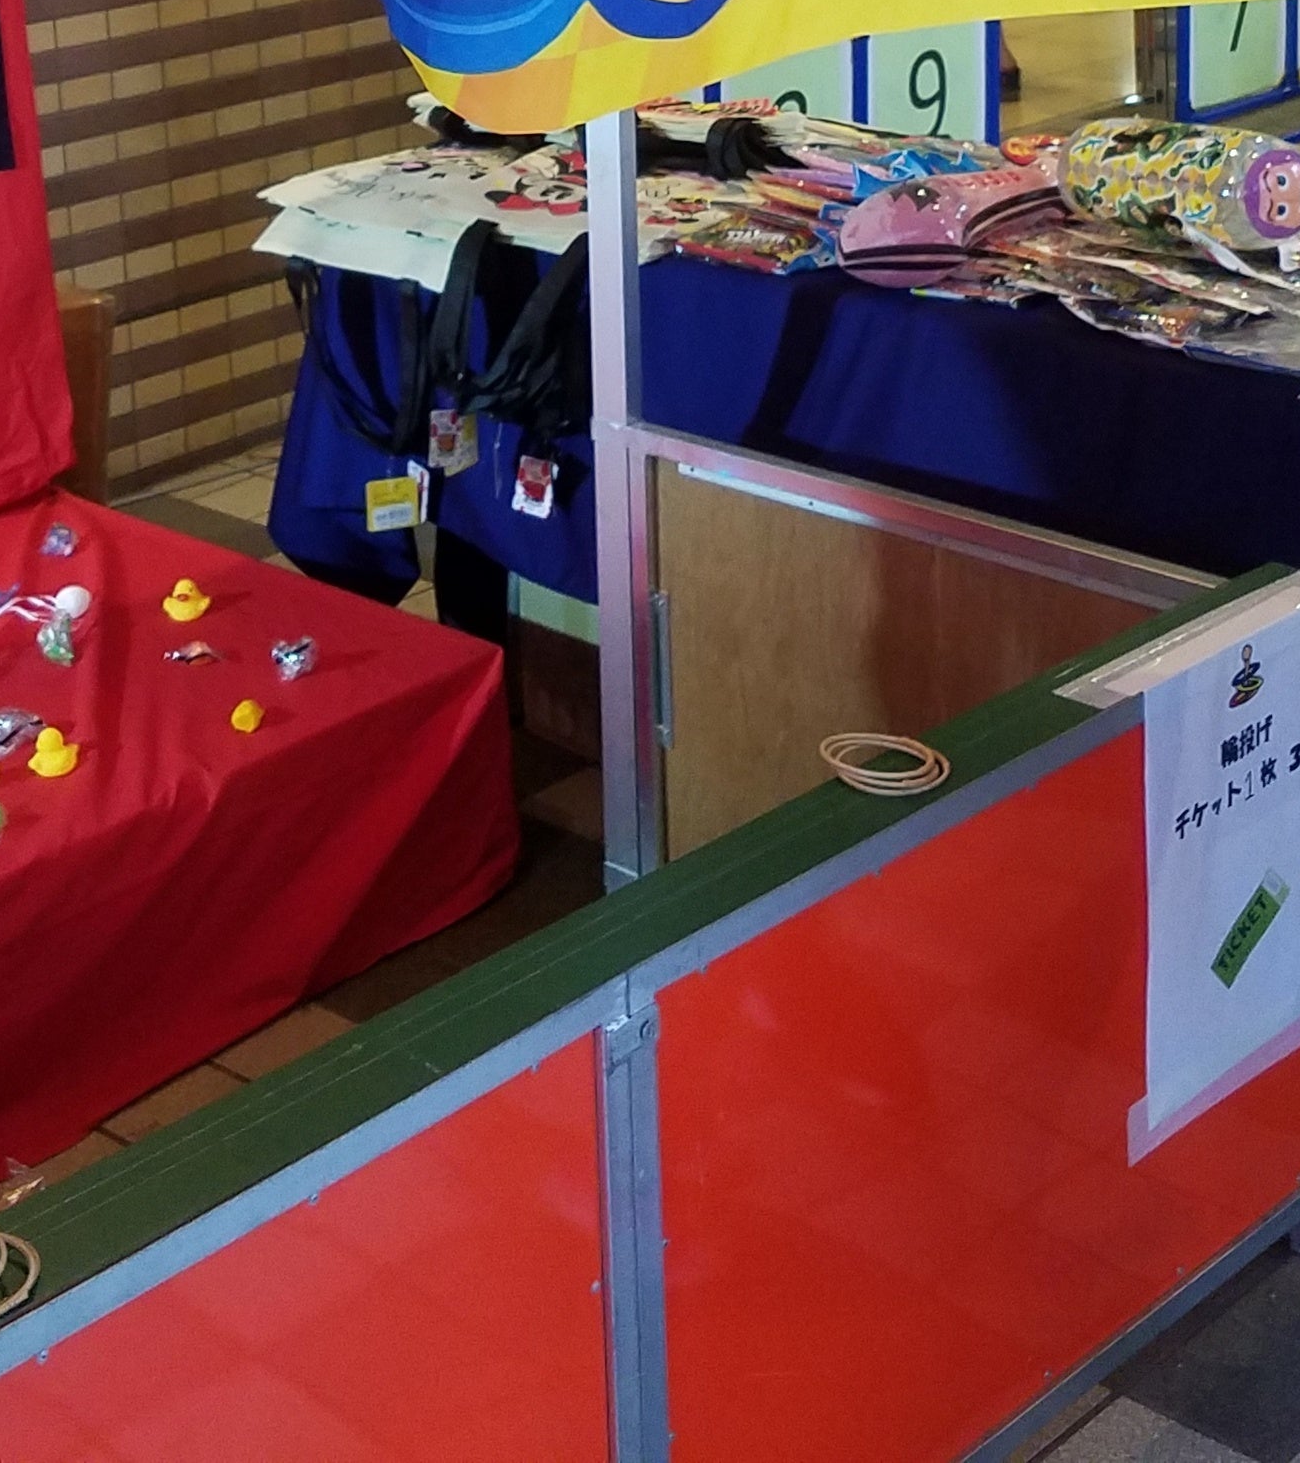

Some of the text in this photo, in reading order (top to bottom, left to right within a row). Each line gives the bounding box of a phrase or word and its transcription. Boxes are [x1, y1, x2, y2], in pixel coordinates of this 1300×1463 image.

[909, 49, 947, 137] 9
[1220, 714, 1273, 769] 輪投げ
[1218, 893, 1267, 971] TICKET
